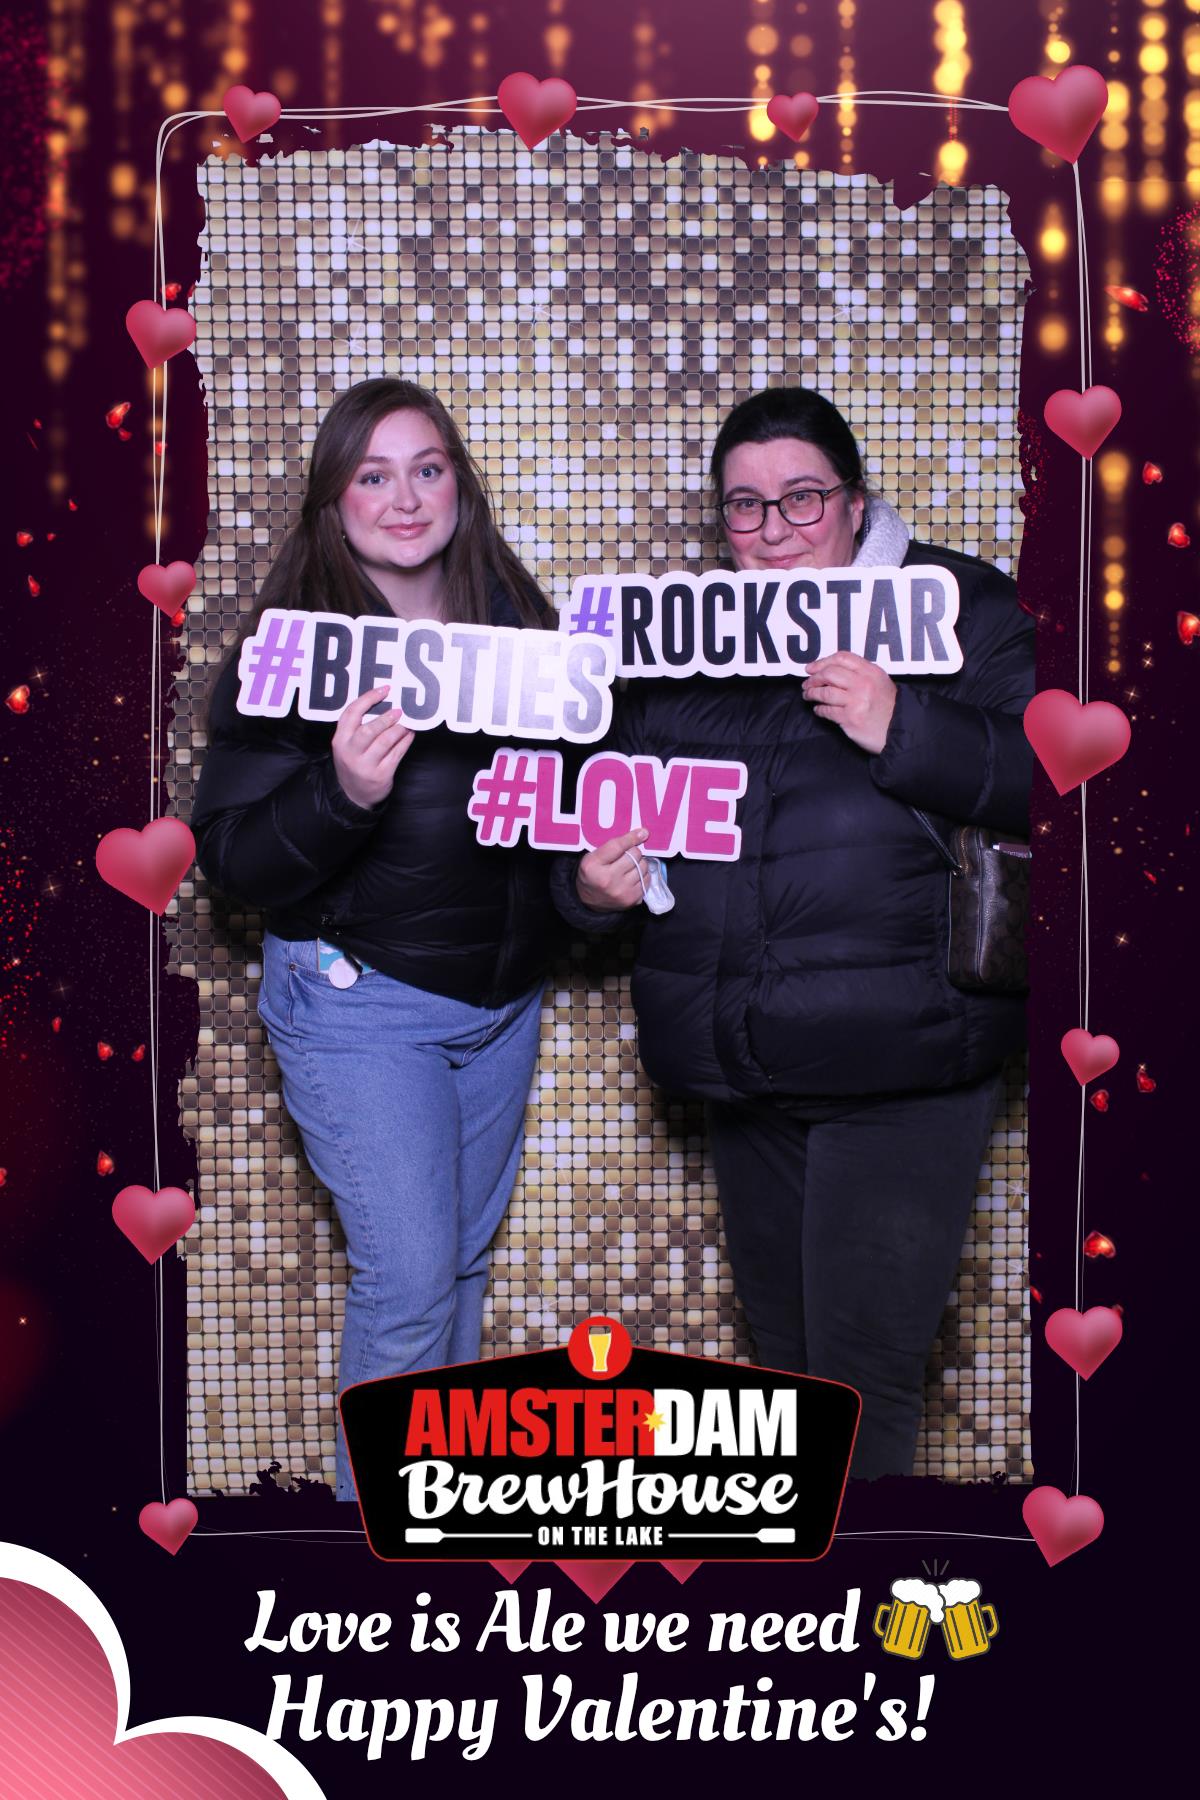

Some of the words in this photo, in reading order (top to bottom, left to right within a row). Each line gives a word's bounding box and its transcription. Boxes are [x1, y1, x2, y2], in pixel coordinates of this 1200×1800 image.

[568, 577, 950, 667] #ROCKSTAR
[246, 617, 607, 735] #BESTIES
[471, 754, 741, 856] #LOVE
